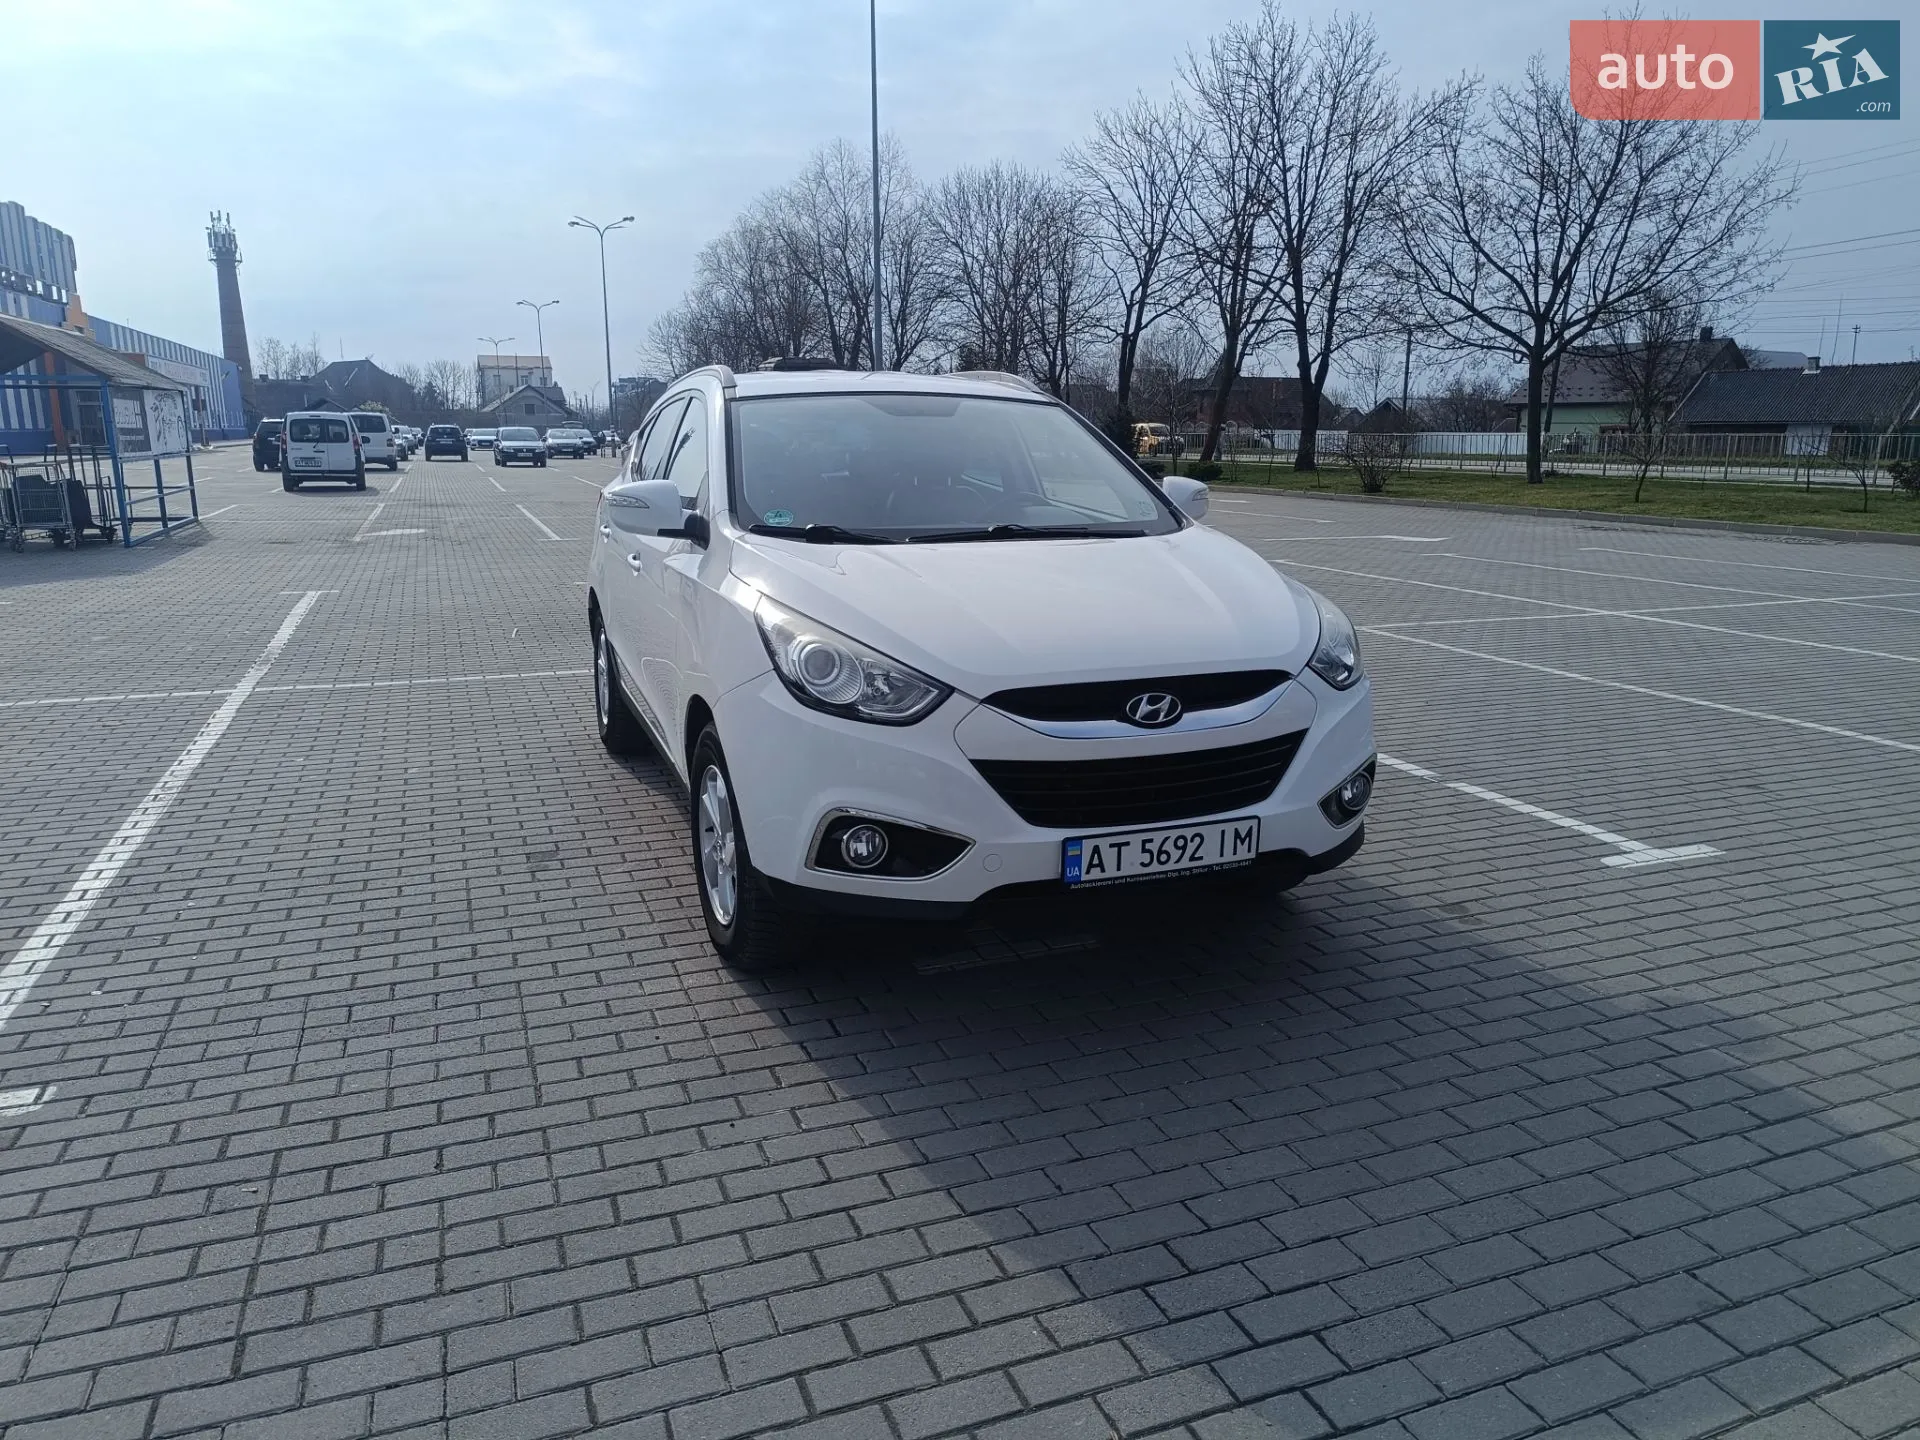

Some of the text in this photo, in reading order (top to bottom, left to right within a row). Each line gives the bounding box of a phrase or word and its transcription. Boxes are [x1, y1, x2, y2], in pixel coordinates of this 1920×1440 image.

[1085, 825, 1254, 875] AT 5692 IM
[1066, 866, 1080, 877] UA
